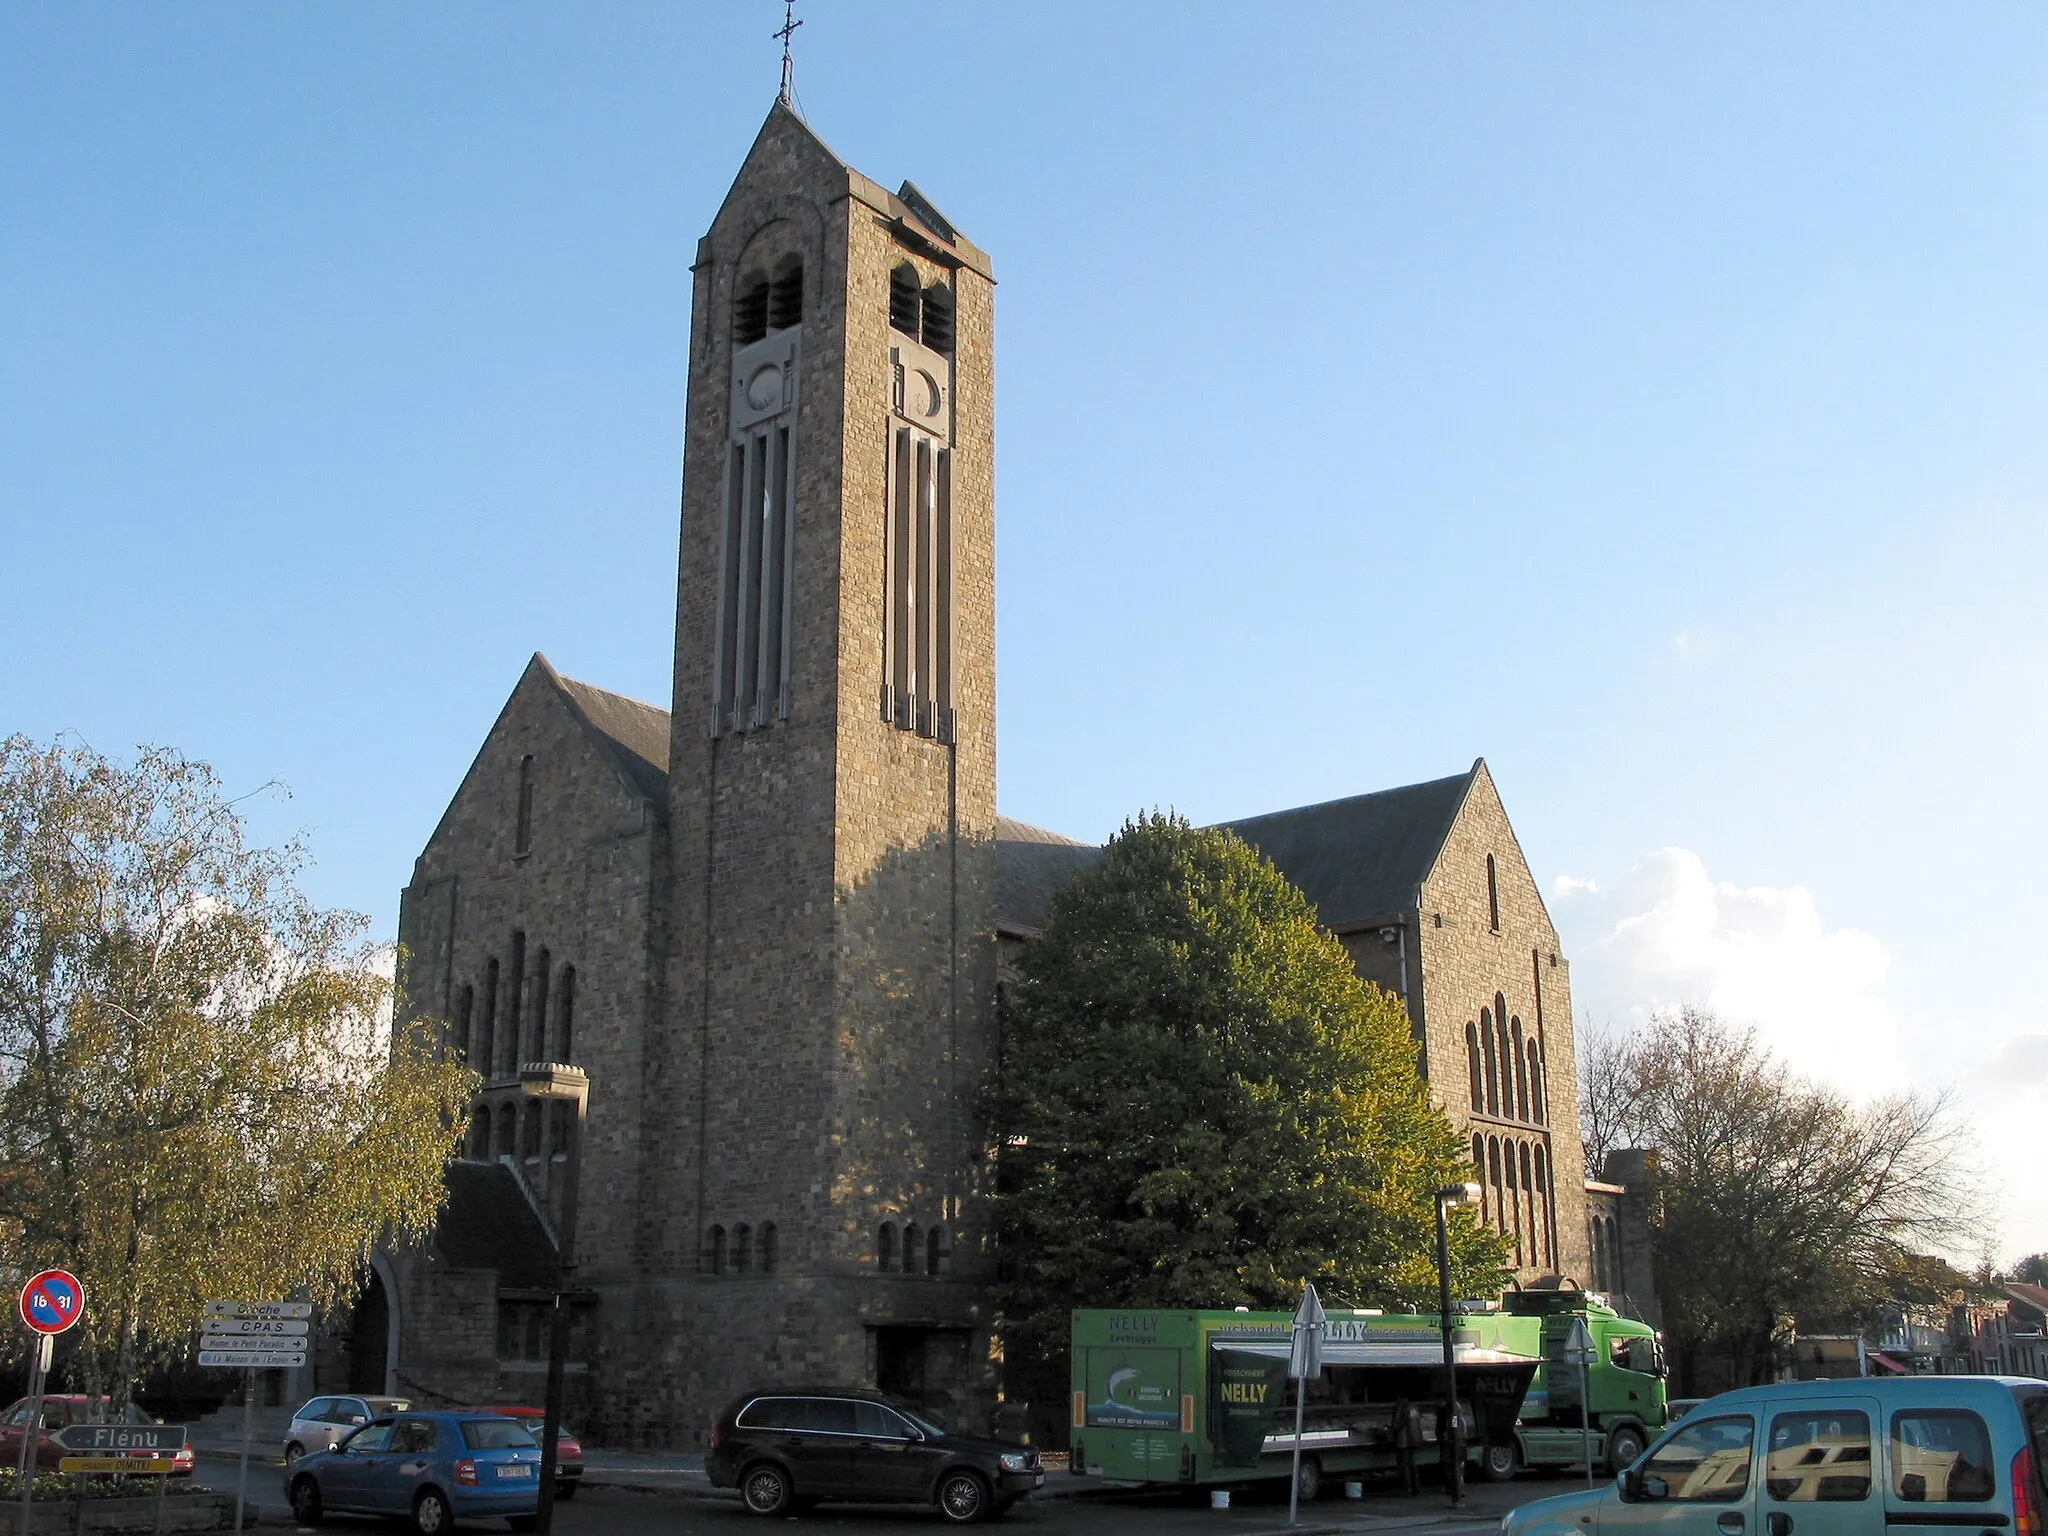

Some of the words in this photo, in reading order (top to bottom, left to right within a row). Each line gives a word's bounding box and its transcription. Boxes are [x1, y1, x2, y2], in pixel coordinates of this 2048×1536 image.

[32, 1294, 48, 1309] 16
[57, 1295, 72, 1309] 31
[237, 1303, 281, 1315] Cche
[1109, 1316, 1159, 1331] NELLY
[1324, 1320, 1367, 1341] LLY
[1221, 1382, 1268, 1403] NELLY
[1475, 1377, 1517, 1394] NELLY
[94, 1428, 158, 1447] Flénu
